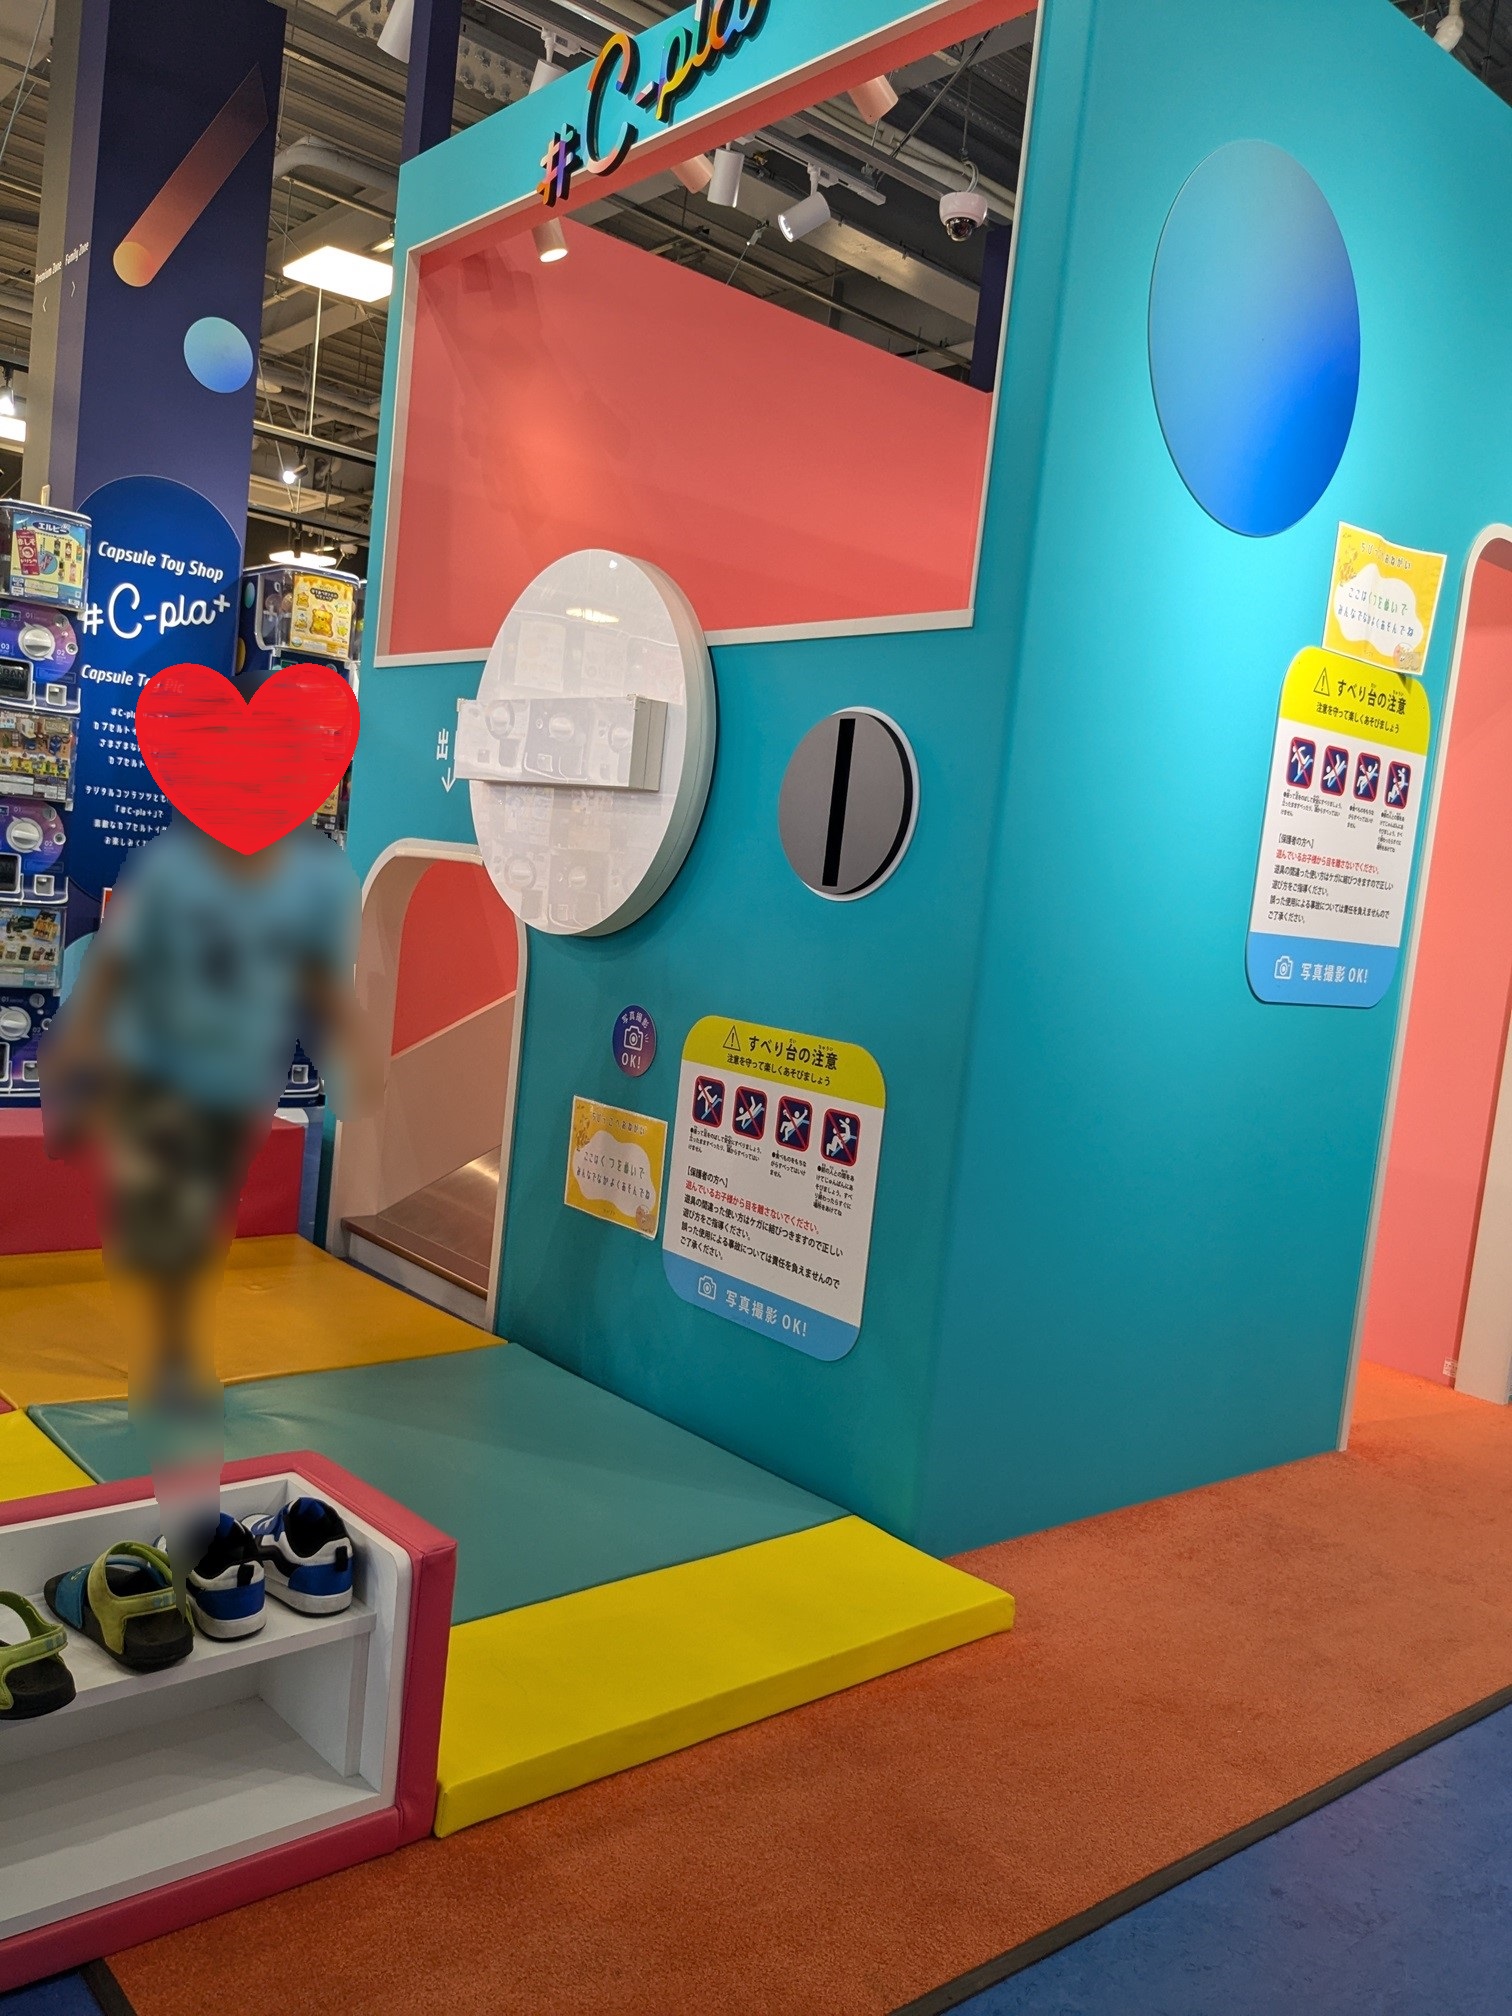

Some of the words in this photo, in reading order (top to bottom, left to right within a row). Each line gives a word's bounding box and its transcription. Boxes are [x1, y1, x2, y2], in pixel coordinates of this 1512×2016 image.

[98, 541, 156, 567] Capsule
[160, 553, 185, 576] Toy
[188, 560, 224, 583] Shop
[81, 664, 133, 686] Capsule
[1338, 680, 1406, 715] すべり台の注意
[1316, 702, 1399, 734] 注意を守って楽しくあそびましょう
[1301, 962, 1346, 983] 写真撮影
[1348, 967, 1369, 984] OK!
[621, 1052, 641, 1069] OK!
[727, 1053, 831, 1087] 注意を守って楽しくあそびましょう
[749, 1035, 839, 1071] すべり台の注意
[687, 1165, 729, 1188] 【保護者の方へ】
[682, 1207, 751, 1241] 遊び方をご指導ください。
[685, 1179, 820, 1235] 遊んでいるお子様から目を離さないでください。
[684, 1193, 844, 1257] 遊具の間違った使い方はケガに結びつきますので正しい
[680, 1235, 723, 1260] ご了承ください。
[681, 1221, 841, 1289] 誤った使用による事故については責任を負えませんので
[725, 1289, 778, 1325] 写真撮影
[782, 1314, 807, 1337] OK!
